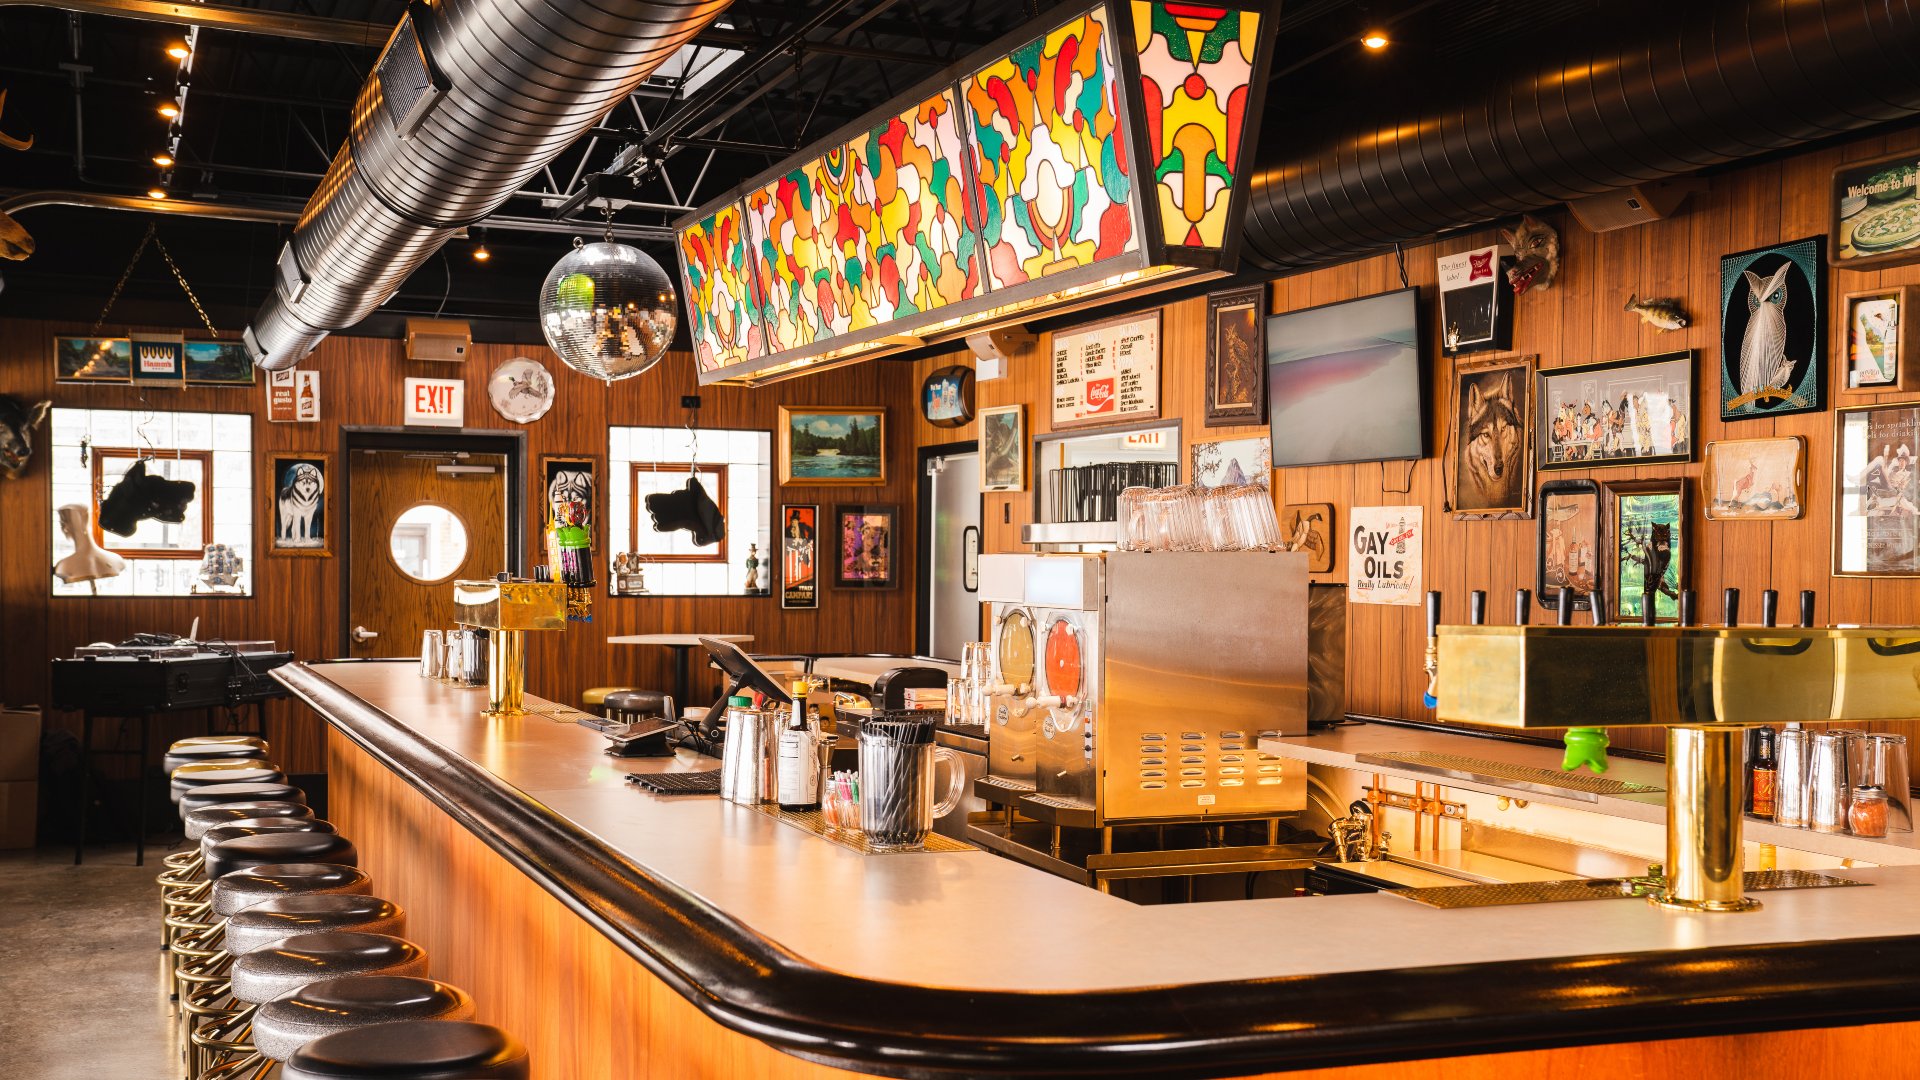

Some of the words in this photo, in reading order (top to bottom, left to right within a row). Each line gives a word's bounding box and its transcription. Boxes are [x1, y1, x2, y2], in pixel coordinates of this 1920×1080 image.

[1848, 182, 1889, 198] Welcome
[1891, 178, 1901, 190] to
[273, 396, 293, 404] gusto
[415, 384, 455, 414] EXIT
[1875, 422, 1885, 430] for
[1879, 430, 1889, 438] for
[1354, 525, 1389, 555] GAY
[1364, 556, 1405, 579] OILS
[1357, 579, 1376, 590] Really
